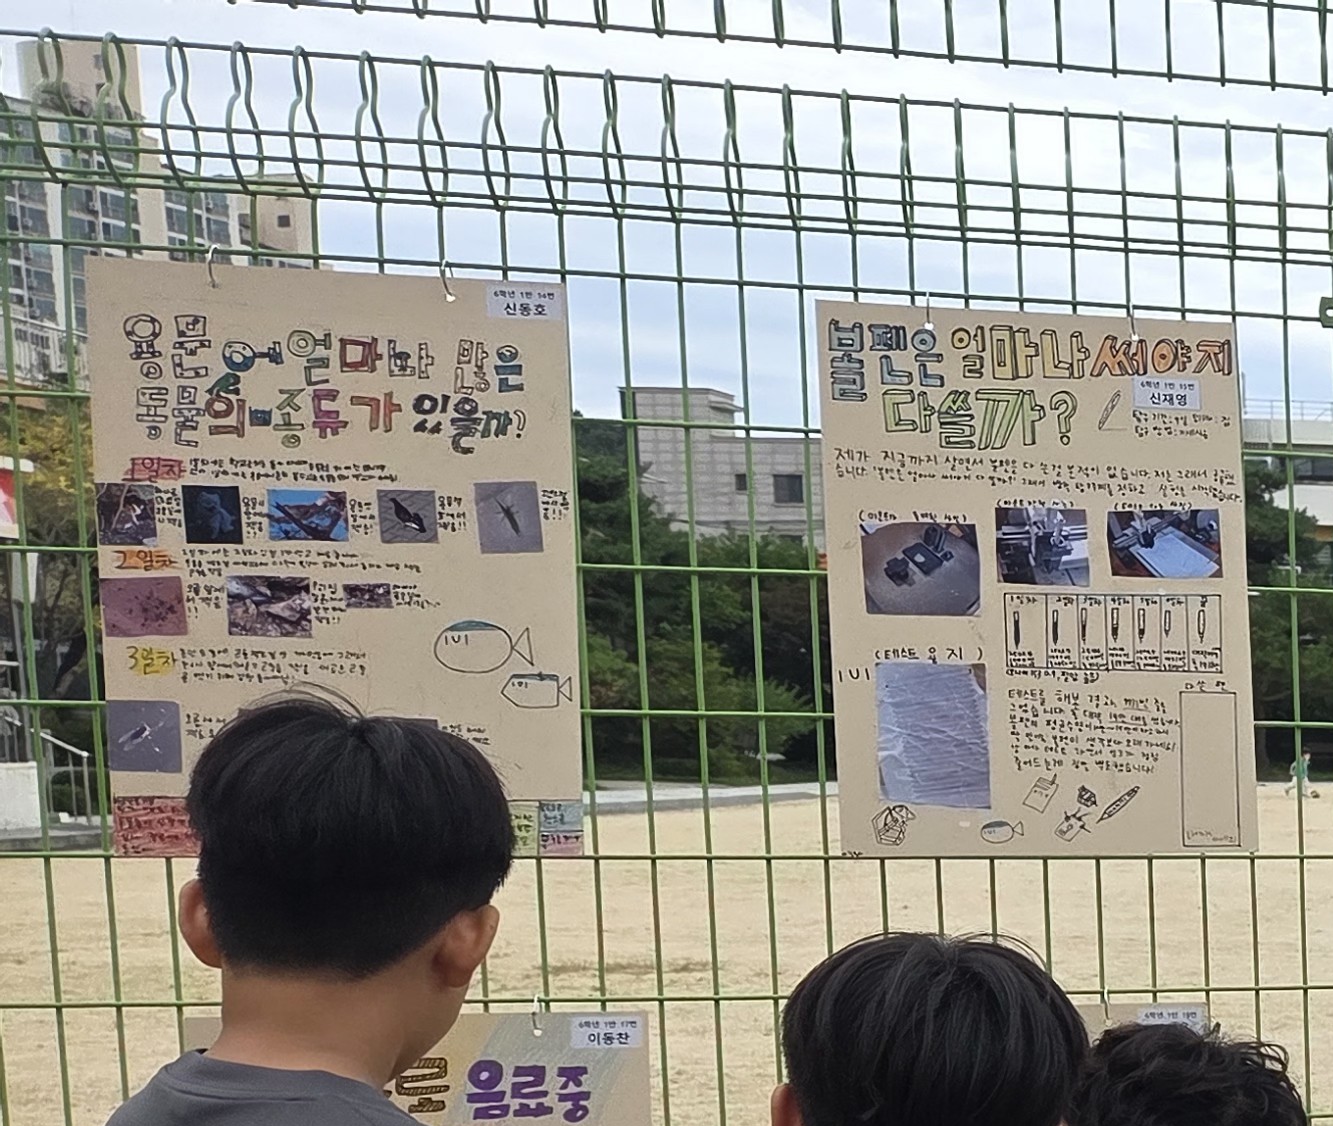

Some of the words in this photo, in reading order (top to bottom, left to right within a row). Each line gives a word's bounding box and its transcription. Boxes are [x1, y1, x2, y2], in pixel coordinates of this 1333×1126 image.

[504, 302, 547, 316] 신동호
[287, 328, 434, 386] 얼마나
[453, 340, 524, 395] 많은
[828, 319, 945, 401] 볼펜은
[950, 325, 1089, 381] 얼마나
[1090, 335, 1231, 379] 써야지
[1150, 392, 1188, 406] 신재영
[136, 386, 246, 448] 동물의
[272, 389, 402, 448] 종류가
[412, 394, 526, 454] 있을까?
[835, 448, 869, 463] 제가
[881, 451, 937, 469] 지금까지
[588, 1032, 631, 1046] 이동찬
